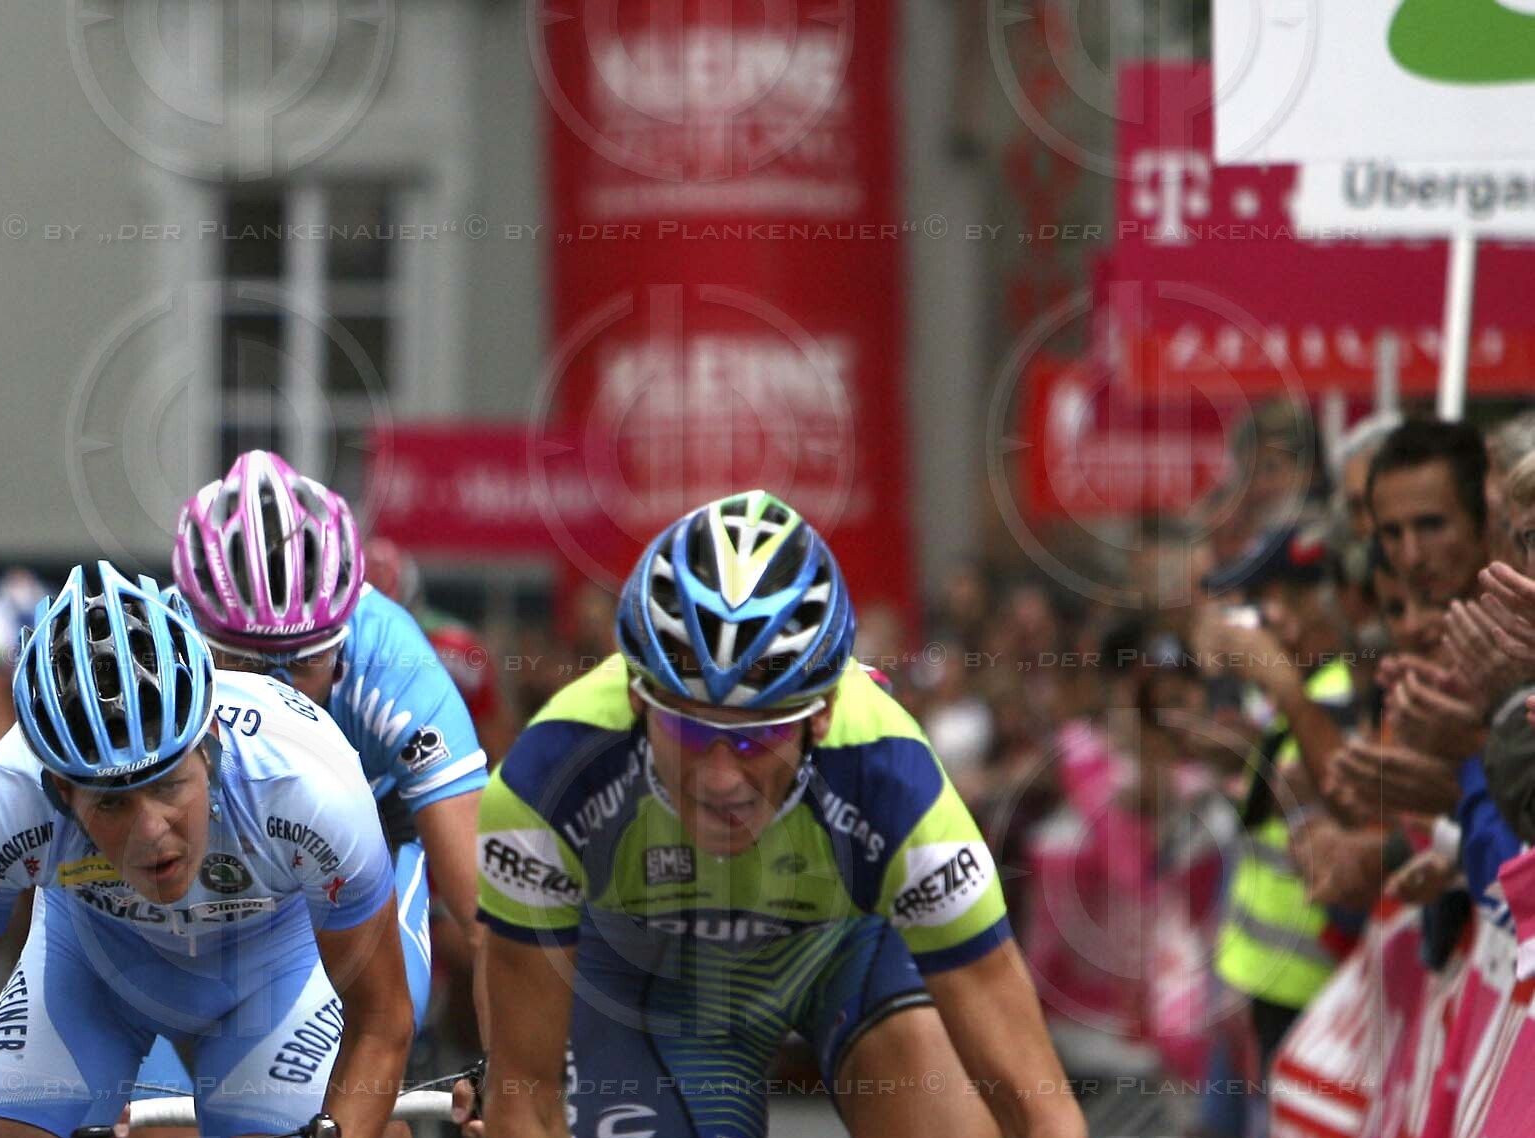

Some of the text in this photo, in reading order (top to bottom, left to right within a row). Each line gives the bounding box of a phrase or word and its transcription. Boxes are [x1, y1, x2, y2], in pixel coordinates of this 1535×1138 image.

[1342, 157, 1535, 221] Überga
[244, 619, 316, 635] SPECIALIZED
[95, 754, 160, 777] SPECIALIZED
[208, 901, 264, 919] Simon
